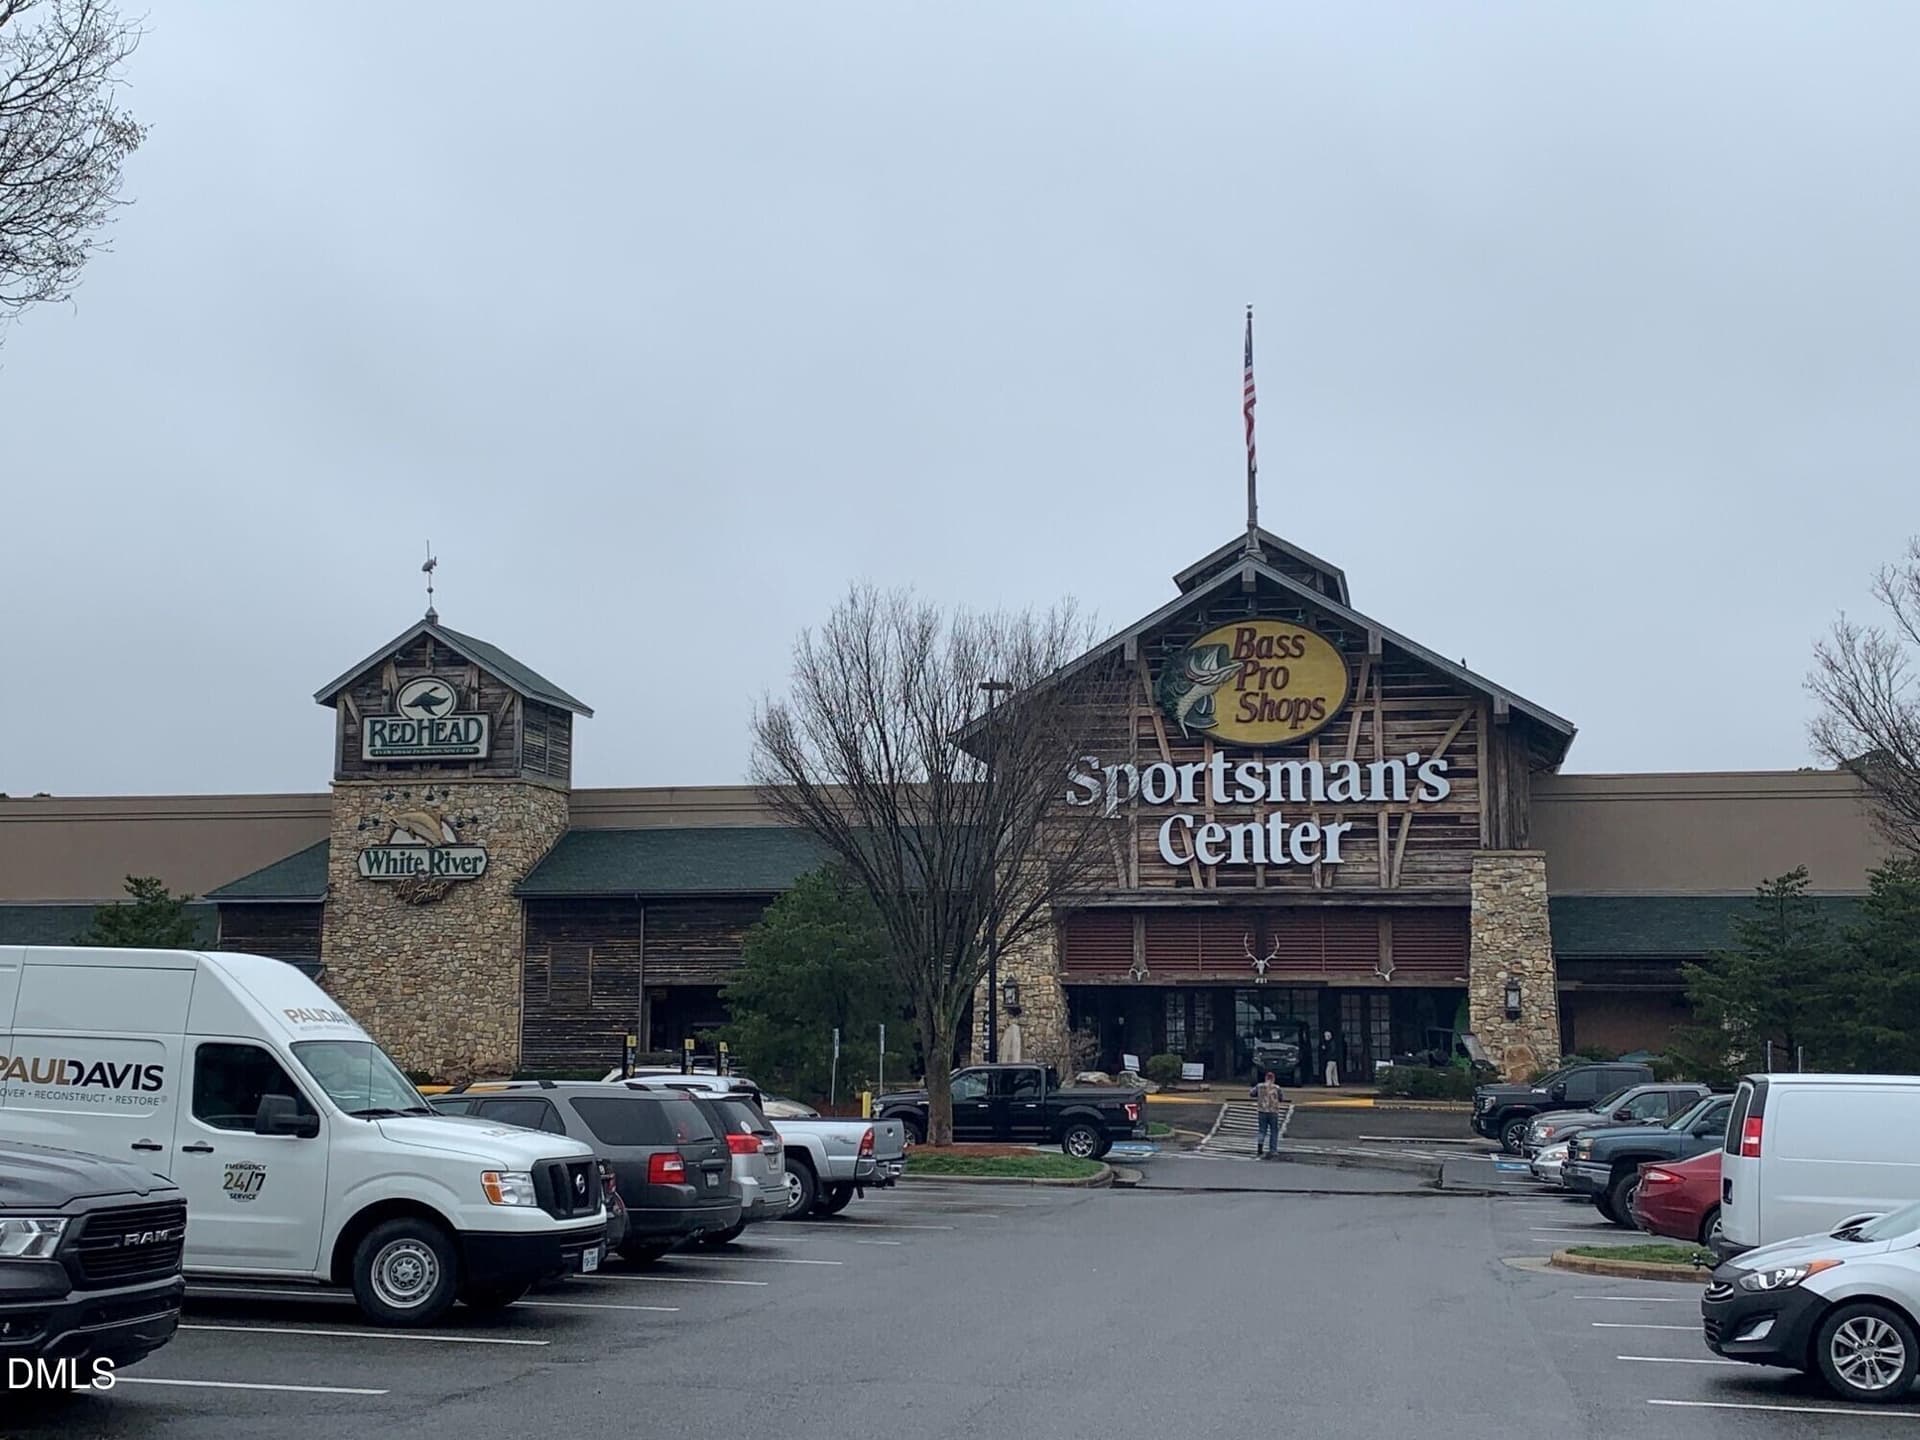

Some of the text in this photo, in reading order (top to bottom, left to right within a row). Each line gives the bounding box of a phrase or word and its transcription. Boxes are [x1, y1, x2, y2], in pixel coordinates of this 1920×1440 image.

[1231, 627, 1305, 660] Bass
[1234, 660, 1290, 691] Pro
[1235, 692, 1326, 730] Shops
[1066, 751, 1452, 819] Sportsman's
[1158, 811, 1352, 866] Center
[364, 848, 484, 876] White River
[34, 1090, 106, 1104] RECONSTRUCT
[115, 1095, 160, 1106] RESTORE
[223, 1171, 266, 1192] 24/7
[124, 1229, 169, 1247] RAM
